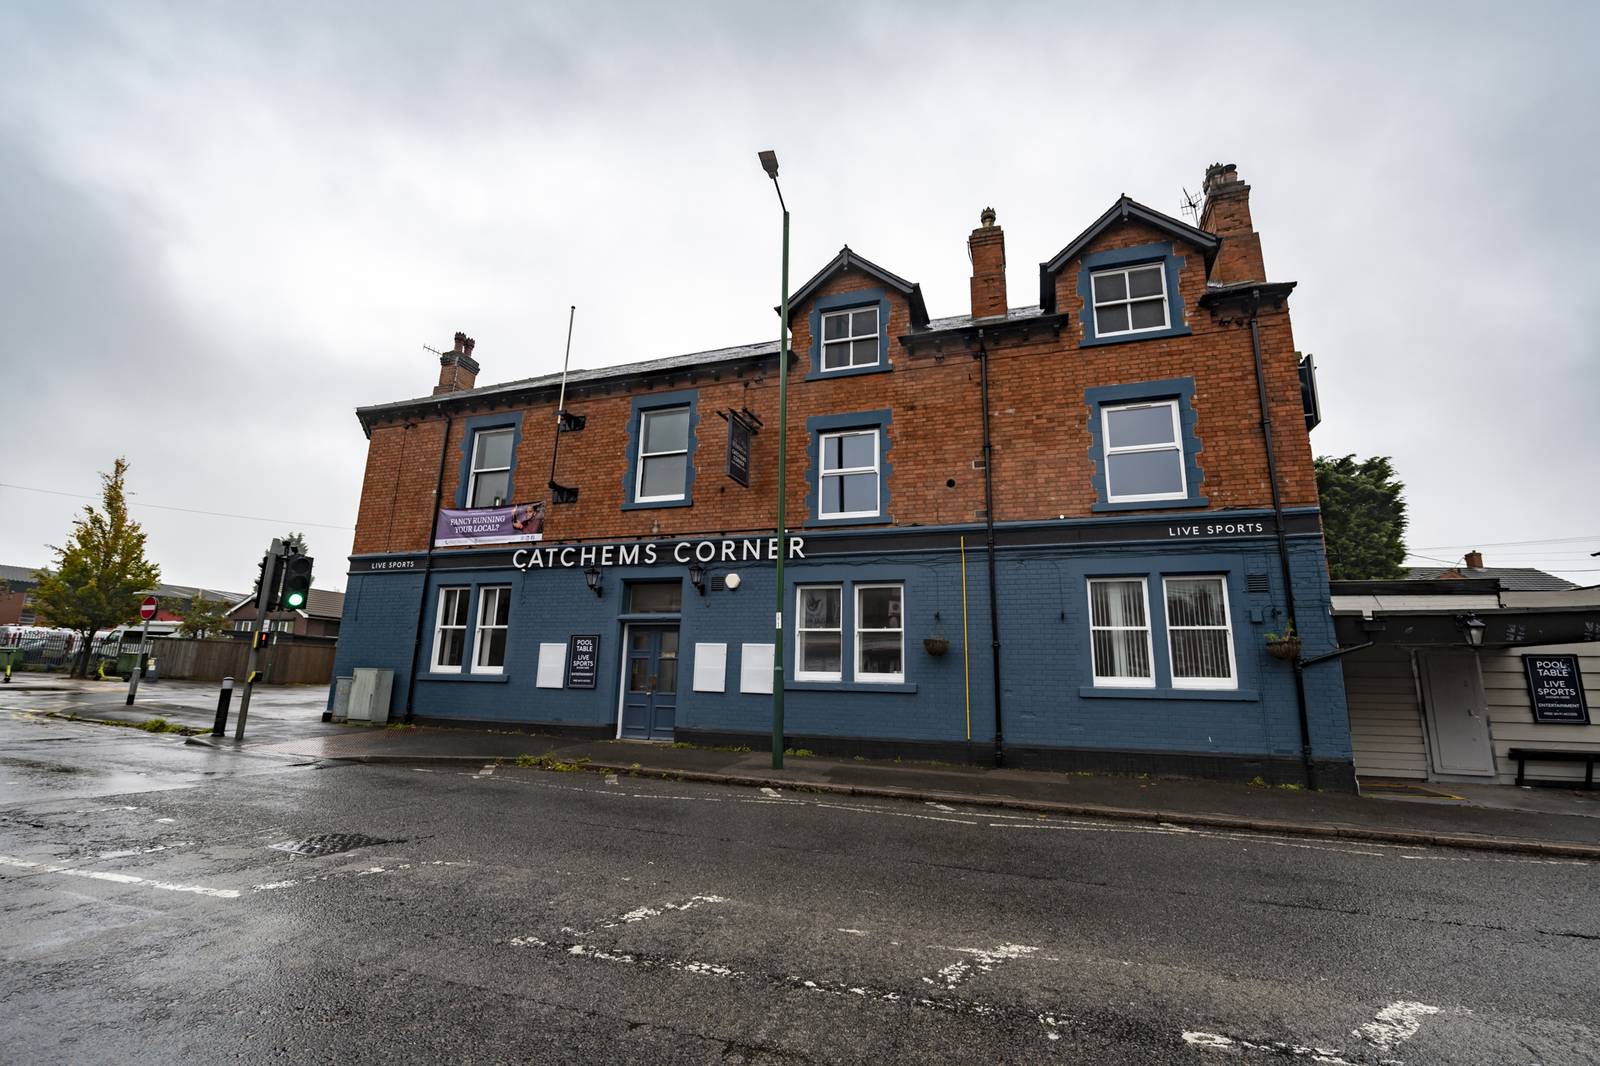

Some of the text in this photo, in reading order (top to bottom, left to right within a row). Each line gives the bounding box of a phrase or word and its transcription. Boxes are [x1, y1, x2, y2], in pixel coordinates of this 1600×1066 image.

[450, 515, 505, 526] FANCY RUNNING
[455, 523, 501, 534] YOUR LOCAL?
[1169, 523, 1263, 536] LIVE SPORTS
[512, 537, 806, 569] CATCHEMS CORNER
[388, 561, 415, 569] SPORTS
[1537, 668, 1569, 677] TABLE
[1544, 680, 1566, 688] LIVE
[1537, 688, 1576, 696] SPORTS
